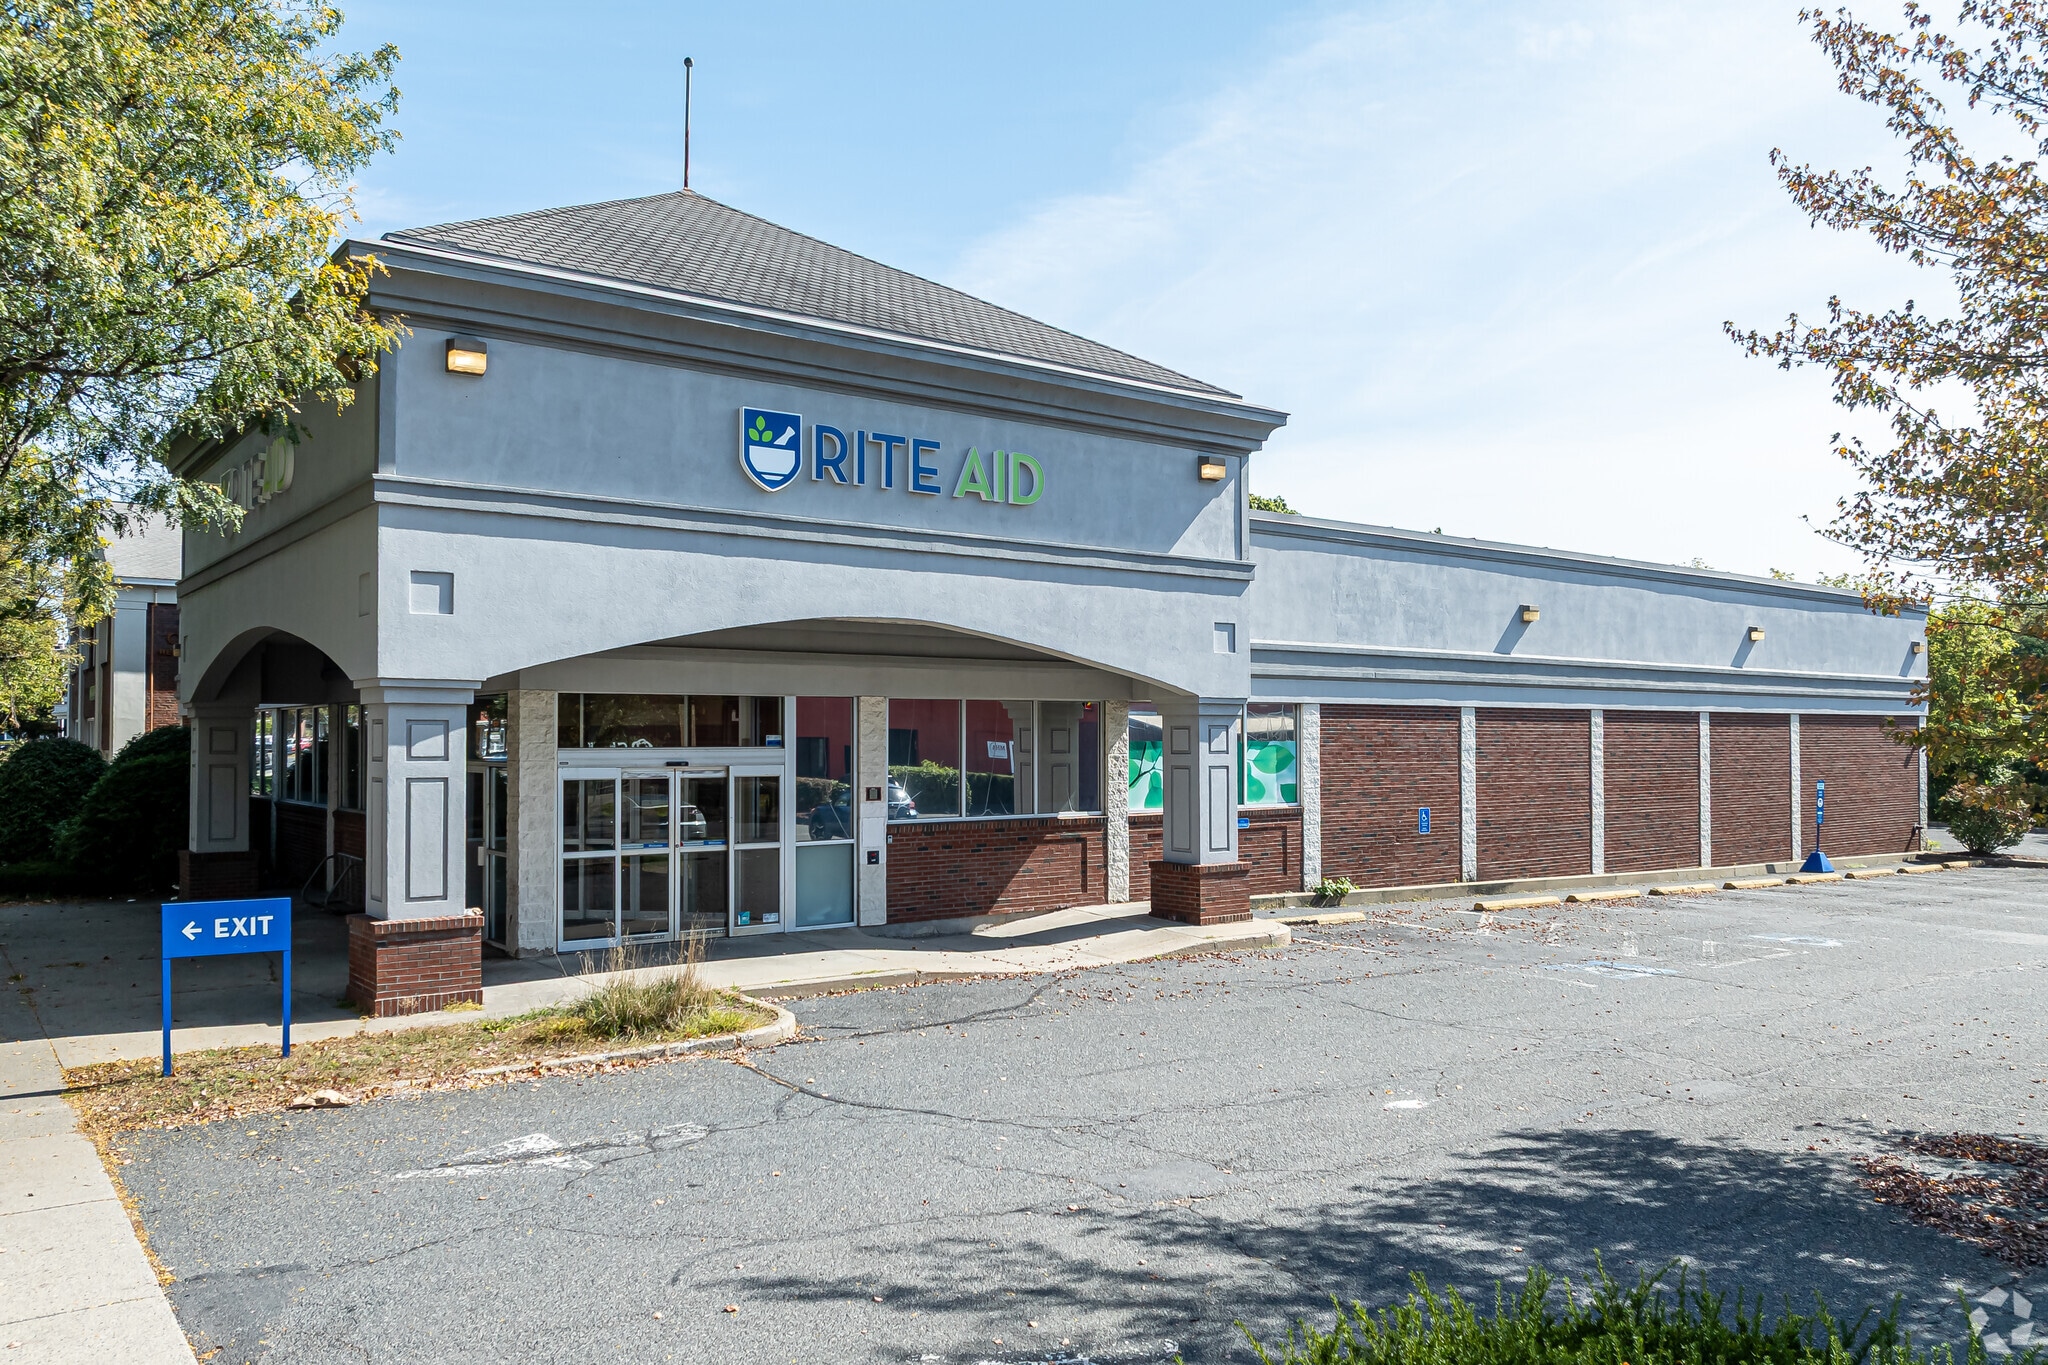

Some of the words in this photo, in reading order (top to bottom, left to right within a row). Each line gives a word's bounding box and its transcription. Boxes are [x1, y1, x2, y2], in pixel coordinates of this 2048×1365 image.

[811, 423, 942, 495] RITE
[952, 446, 1046, 505] AID
[214, 915, 274, 938] EXIT
